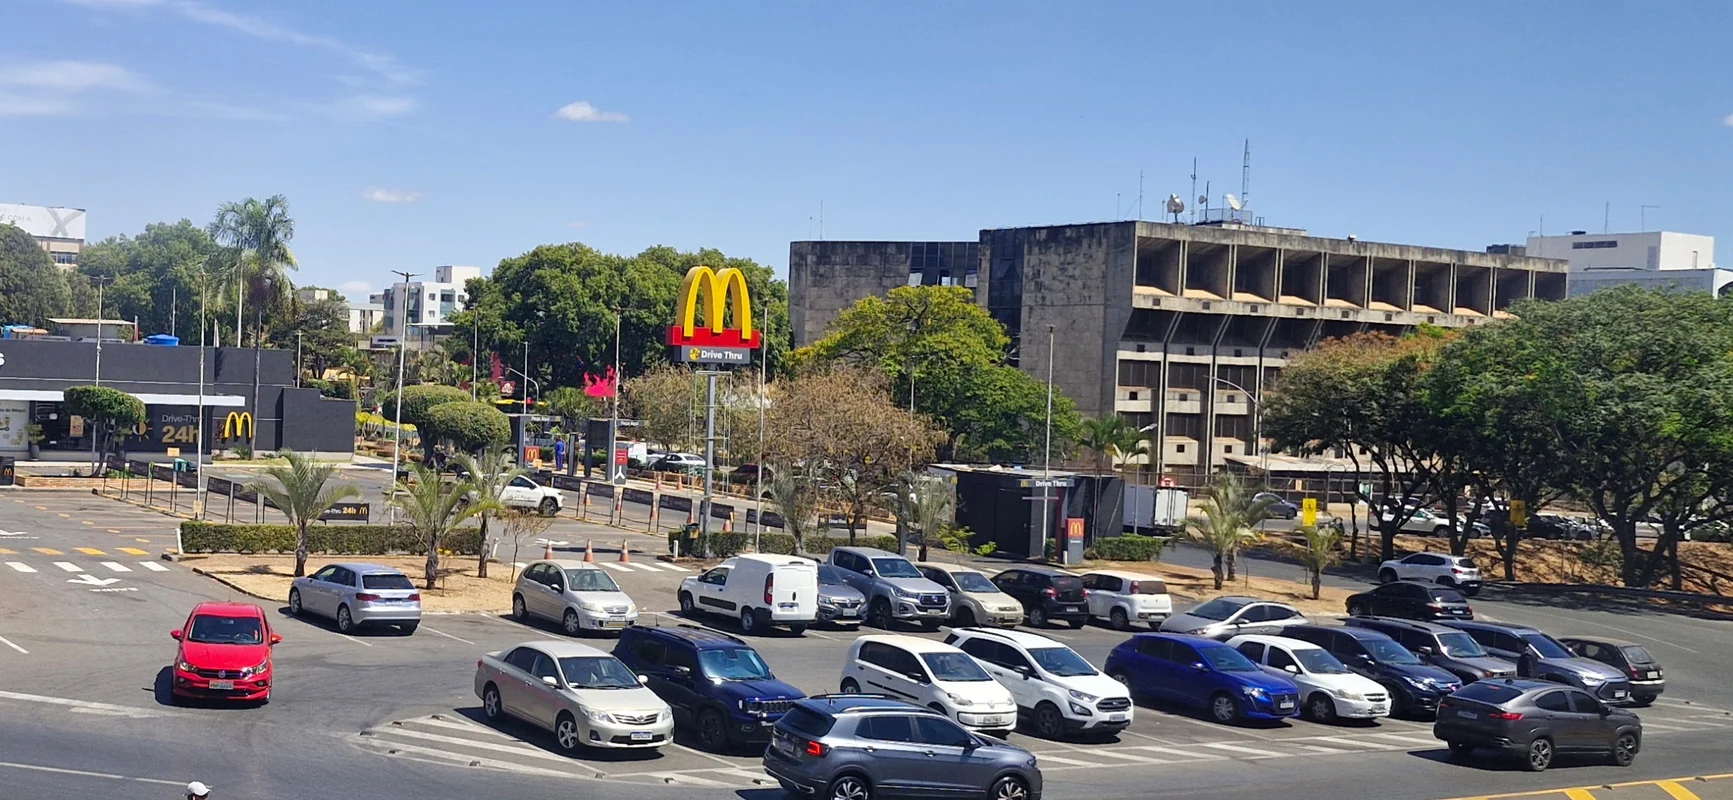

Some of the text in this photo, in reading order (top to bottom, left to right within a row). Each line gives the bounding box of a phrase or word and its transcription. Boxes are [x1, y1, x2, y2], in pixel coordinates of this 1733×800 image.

[701, 350, 743, 360] Drive Thru
[162, 425, 200, 443] 24h
